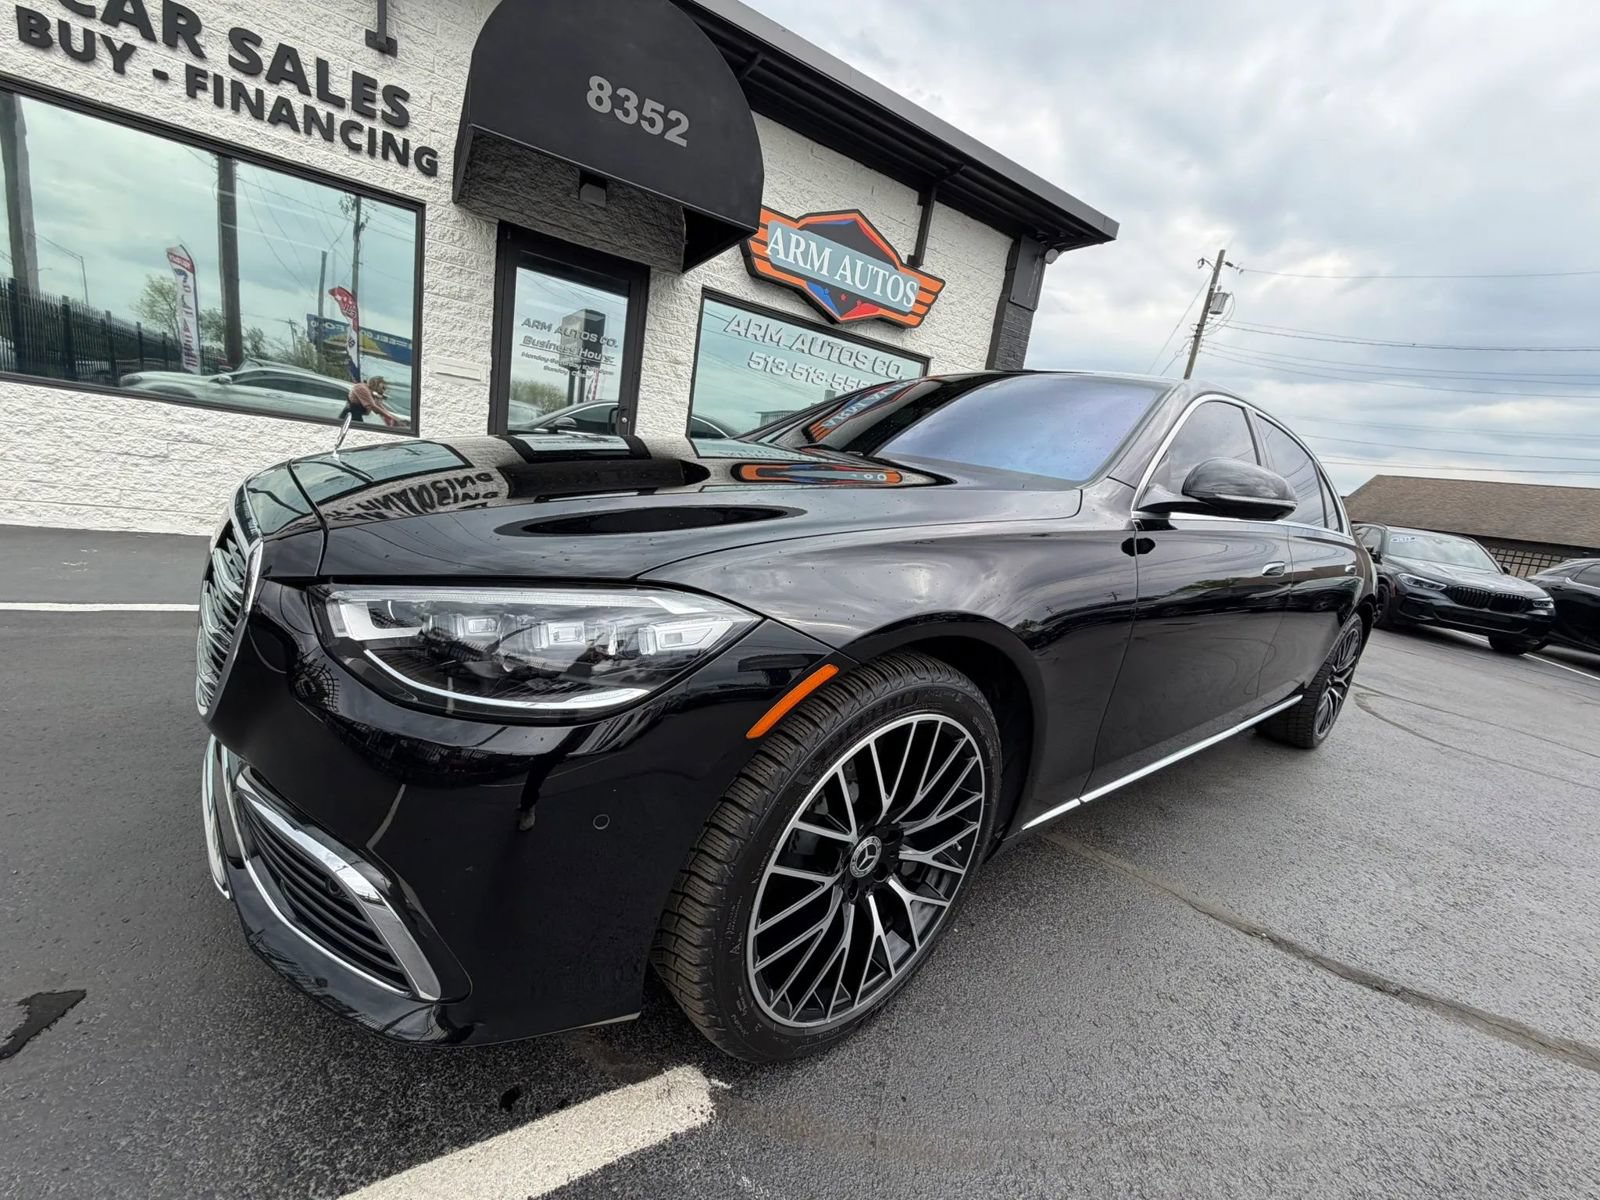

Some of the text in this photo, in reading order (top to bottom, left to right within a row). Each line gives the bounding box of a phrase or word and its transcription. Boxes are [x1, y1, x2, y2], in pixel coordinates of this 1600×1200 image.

[16, 5, 137, 75] BUY
[185, 63, 439, 177] FINANCING
[228, 26, 411, 129] SALES
[586, 75, 690, 148] 8352
[765, 227, 918, 308] ARM AUTOS
[521, 317, 553, 332] ARM
[554, 327, 598, 343] AUTOS
[522, 335, 578, 354] Business
[723, 314, 784, 347] ARM
[789, 333, 869, 371] AUTOS
